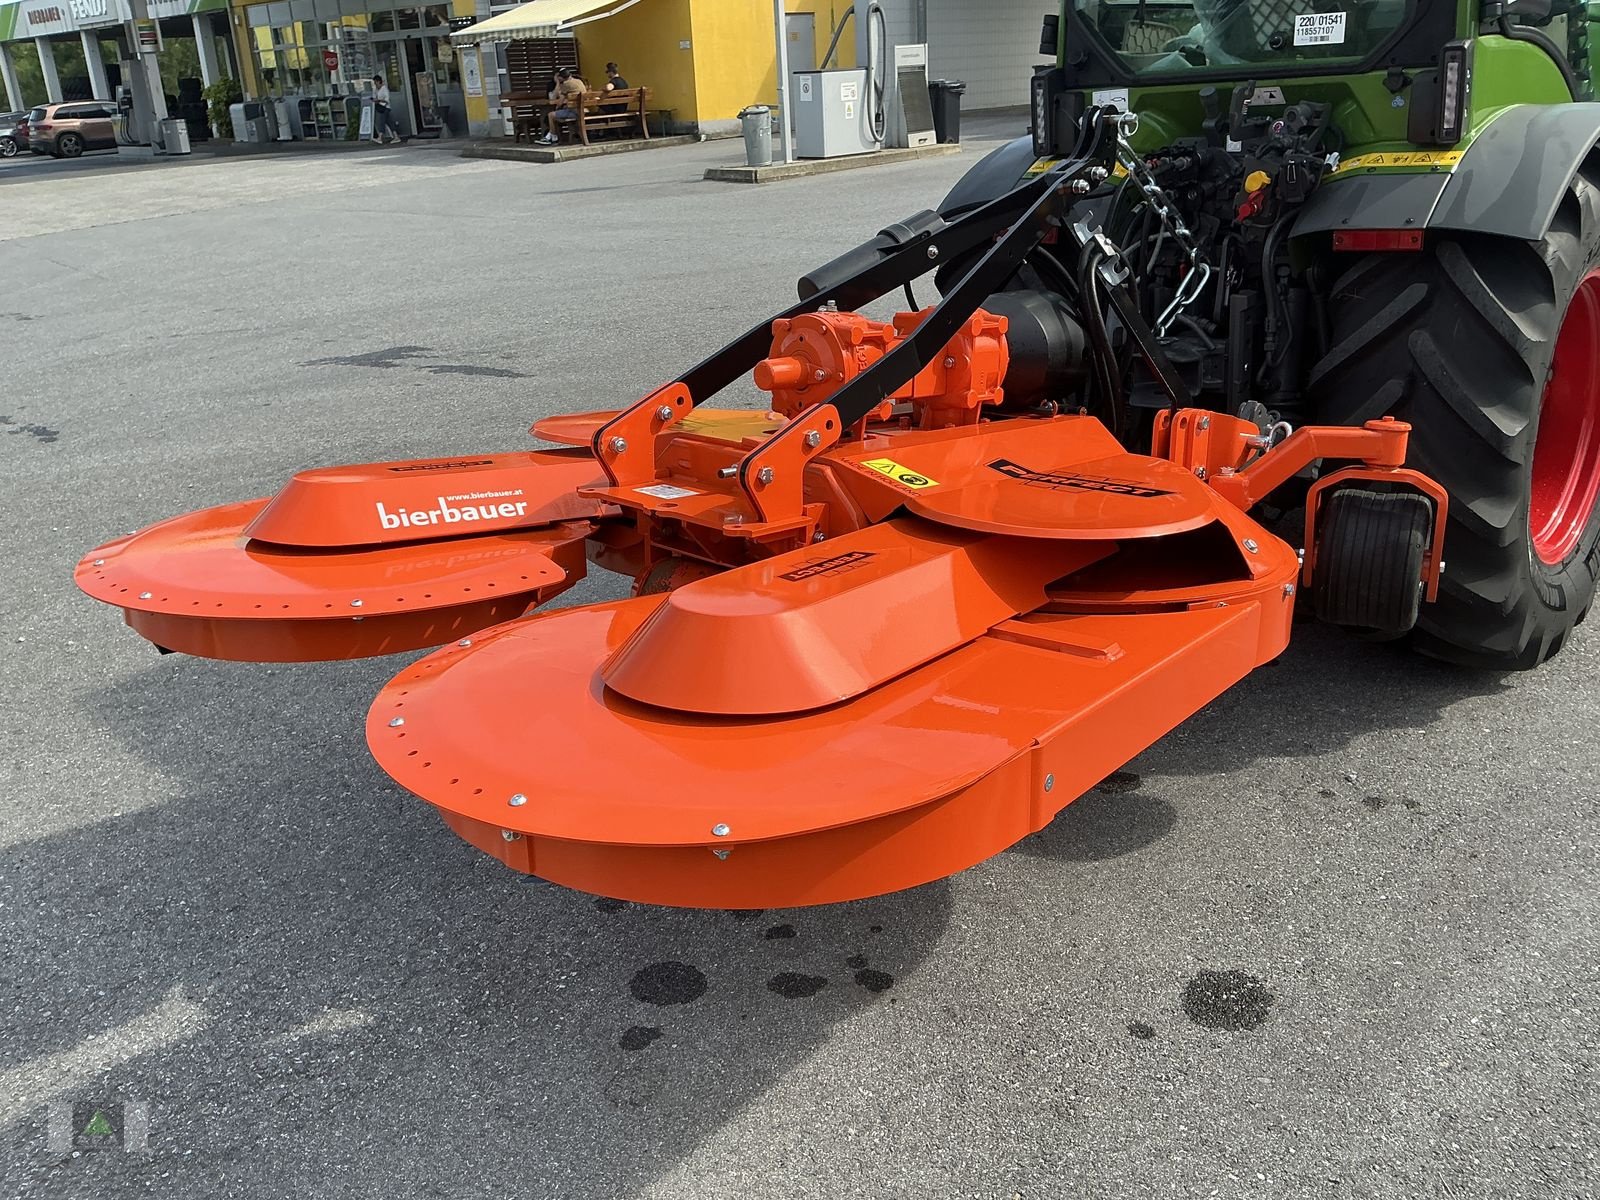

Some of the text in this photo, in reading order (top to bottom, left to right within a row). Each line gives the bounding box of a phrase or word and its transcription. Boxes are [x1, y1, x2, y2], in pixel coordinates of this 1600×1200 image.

[1297, 26, 1335, 36] 118557107
[999, 464, 1157, 496] PERFECT
[446, 489, 524, 502] www.bierbauer.at
[376, 496, 528, 529] bierbauer
[789, 552, 867, 580] PERFECT
